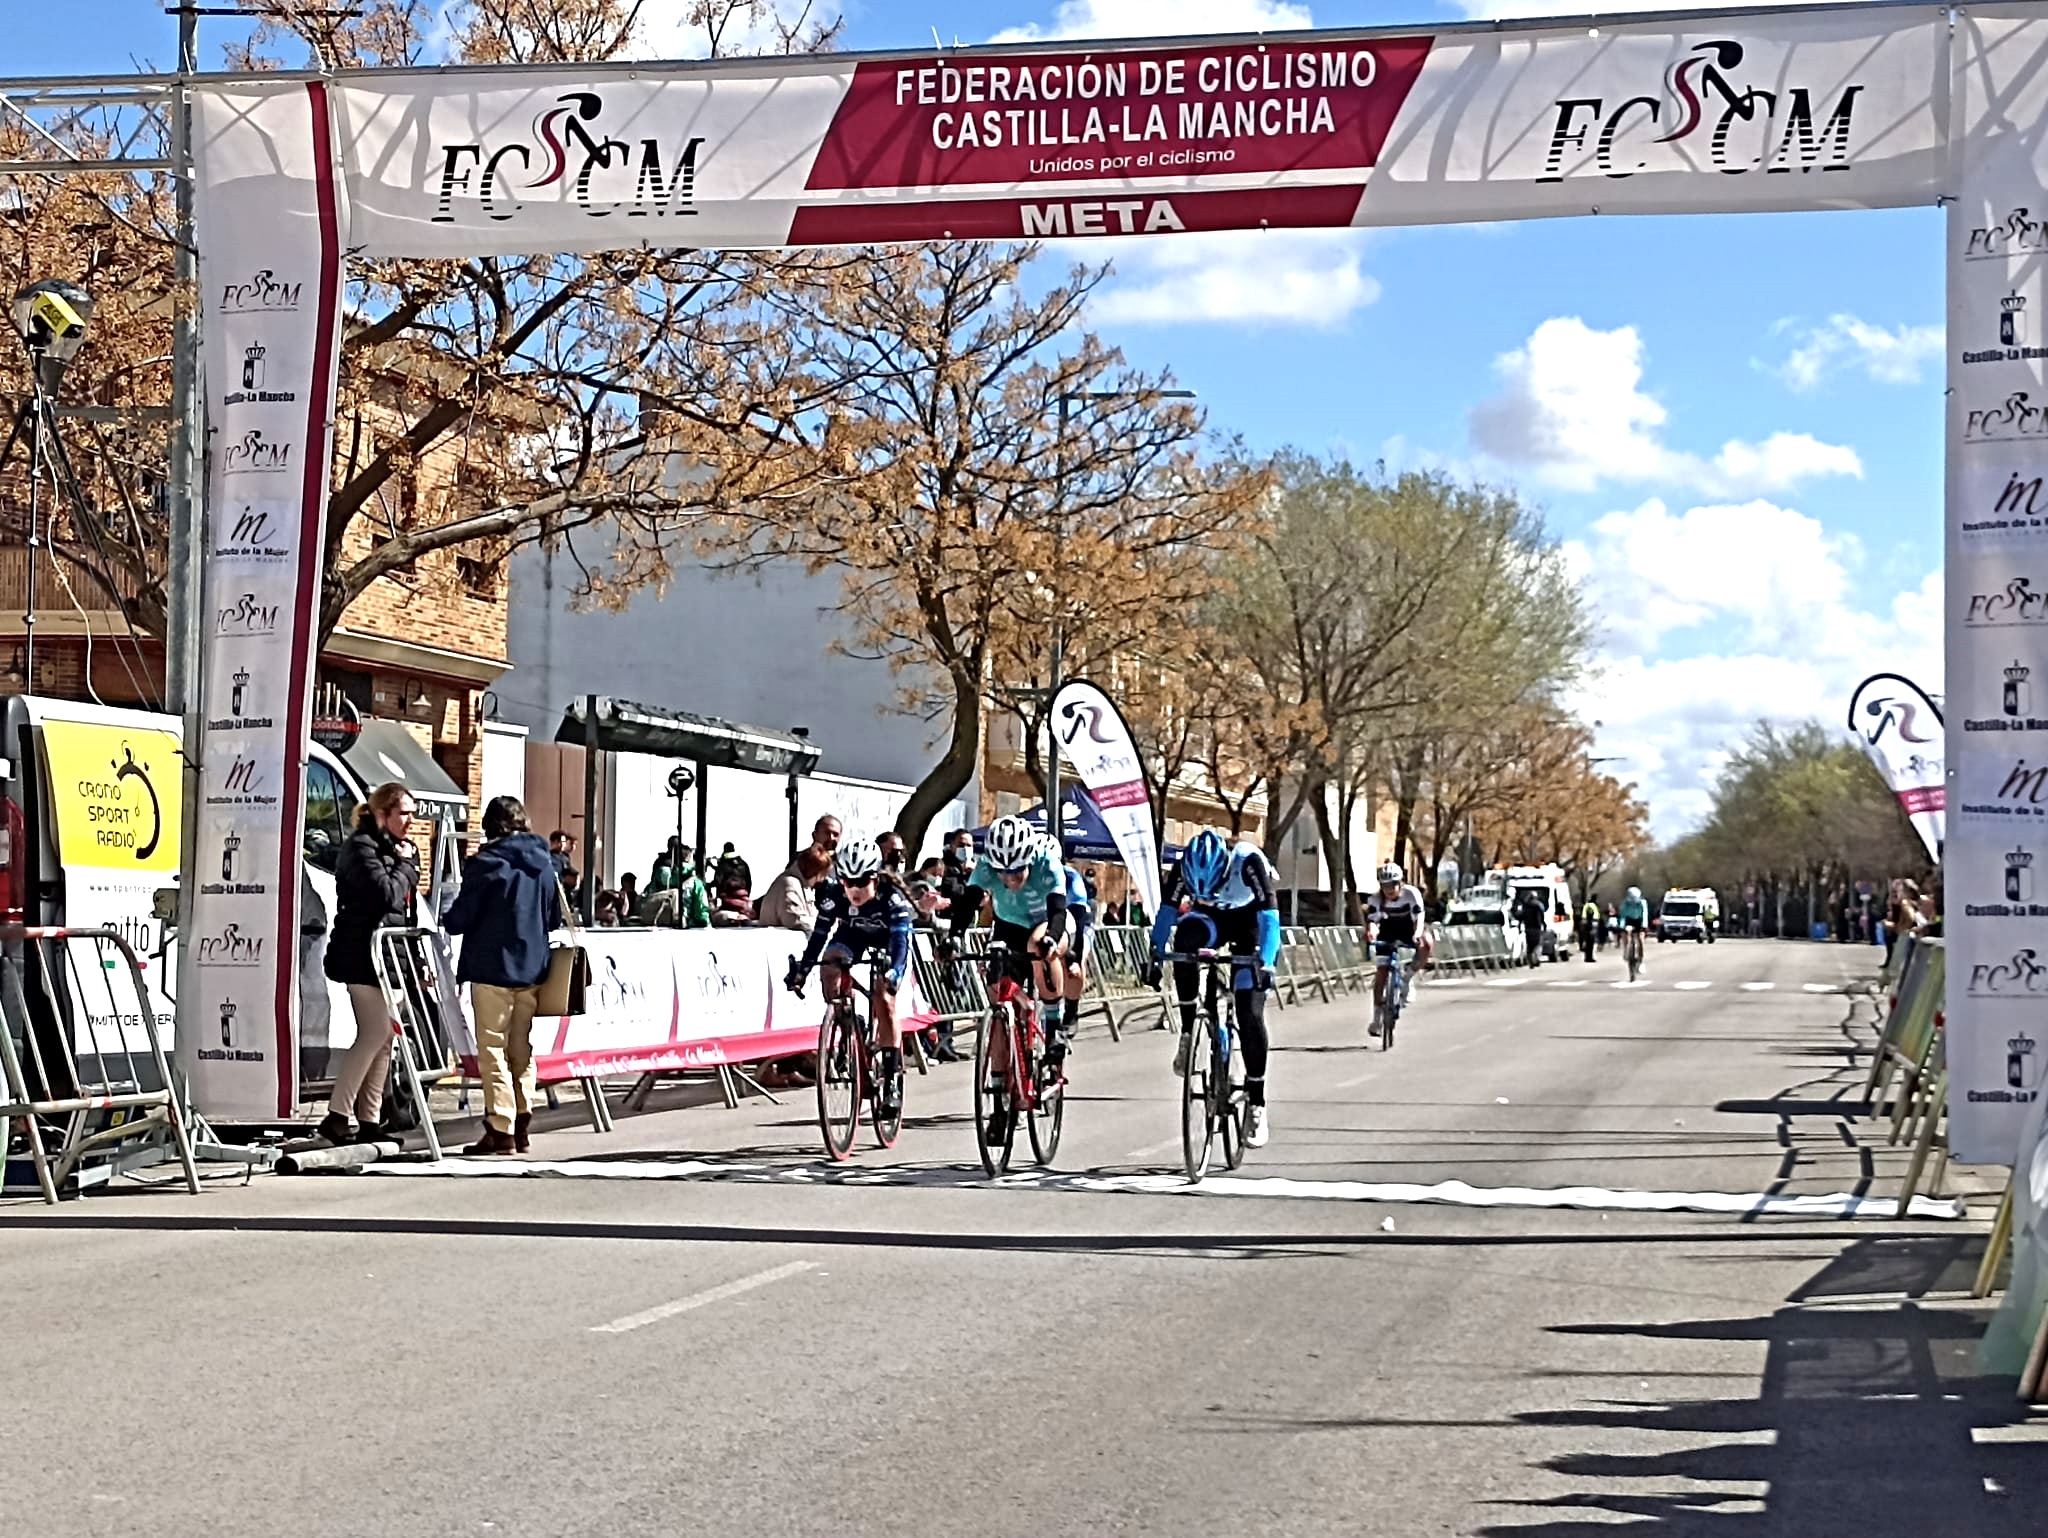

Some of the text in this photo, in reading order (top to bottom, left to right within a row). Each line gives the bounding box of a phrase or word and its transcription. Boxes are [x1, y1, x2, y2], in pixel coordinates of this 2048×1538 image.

[896, 51, 1376, 105] FEDERACIÓN DE CICLISMO
[932, 96, 1336, 150] CASTILLA-LA MANCHA
[1029, 148, 1236, 174] Unidos por el ciclismo
[1019, 200, 1186, 236] META
[78, 781, 122, 801] CRONO
[88, 805, 130, 825] SPORT
[97, 830, 135, 849] RADIO
